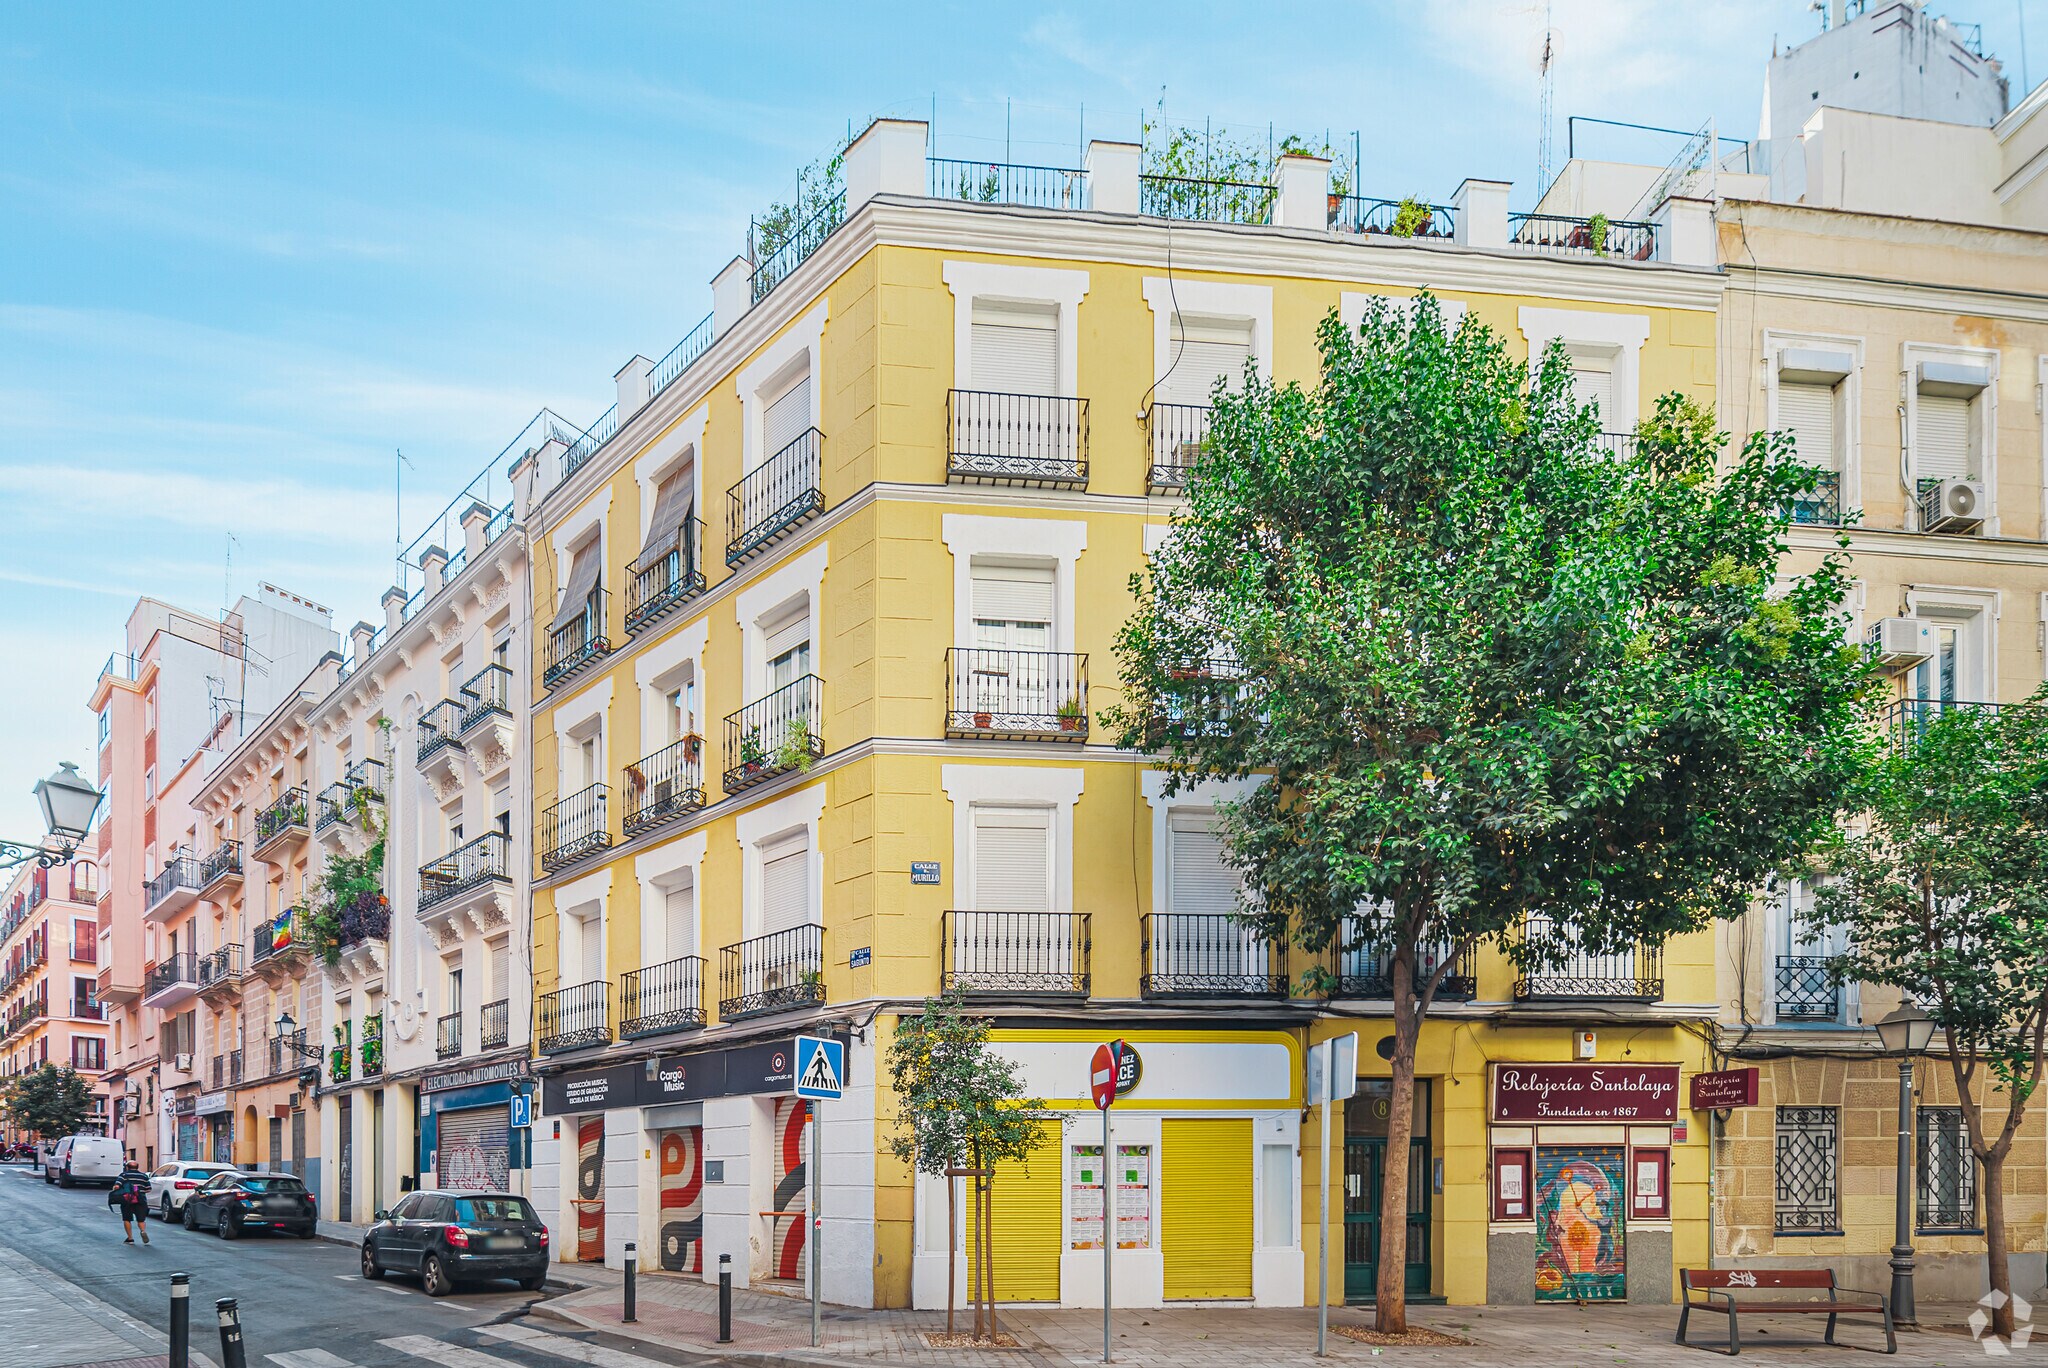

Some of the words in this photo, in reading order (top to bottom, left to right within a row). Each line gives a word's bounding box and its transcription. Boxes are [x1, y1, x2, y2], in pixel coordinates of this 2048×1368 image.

[912, 874, 940, 882] MURILLO
[855, 947, 870, 955] CALLE
[427, 1071, 467, 1091] ELECTRICIDAD
[472, 1061, 518, 1082] AUTOMOVILES
[660, 1070, 682, 1082] Cargo
[1698, 1076, 1741, 1088] Relojería
[664, 1080, 685, 1092] Music
[1502, 1070, 1584, 1099] Relojería
[1590, 1070, 1674, 1100] Santolaya
[1698, 1086, 1743, 1099] Santolaya
[515, 1098, 524, 1123] P
[1379, 1100, 1387, 1116] 8
[1538, 1102, 1593, 1117] Fundada
[1612, 1106, 1638, 1117] 1867
